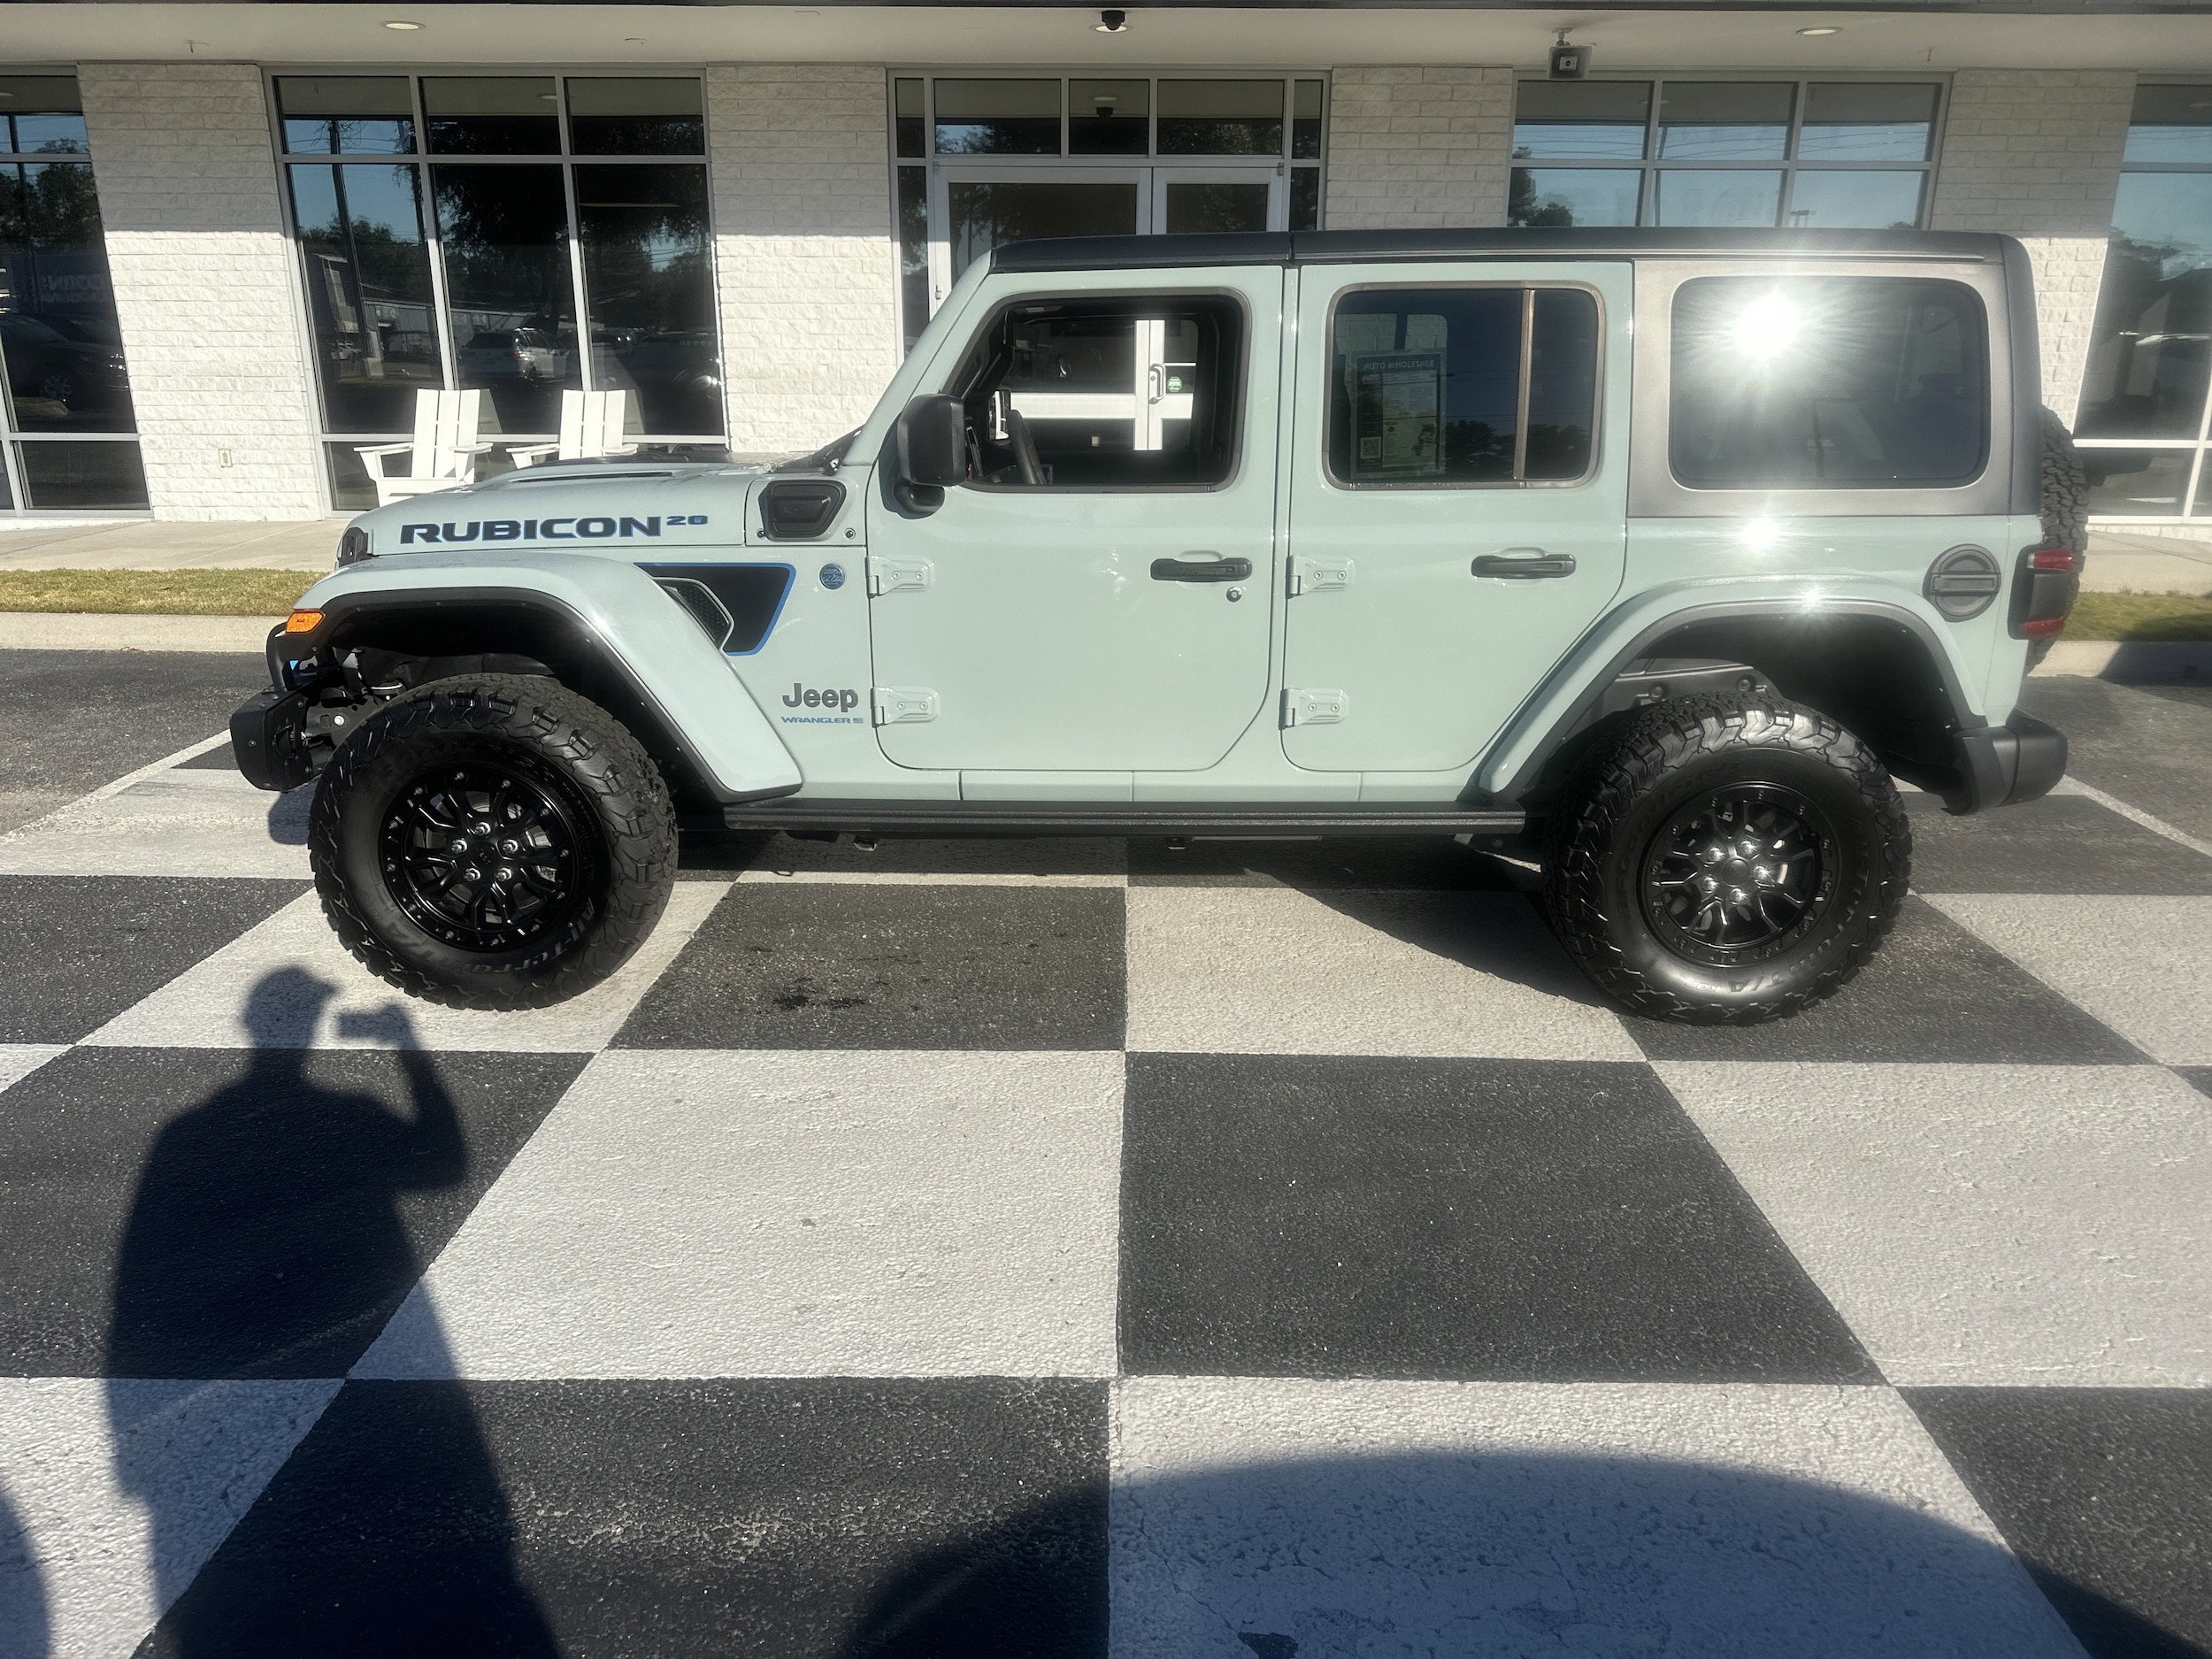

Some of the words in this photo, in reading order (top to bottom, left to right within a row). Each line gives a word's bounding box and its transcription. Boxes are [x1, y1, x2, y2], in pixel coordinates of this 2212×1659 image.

[1363, 361, 1386, 370] AUTO
[1387, 359, 1435, 369] WHOLESALE
[400, 516, 662, 545] RUBICON
[781, 682, 859, 713] Jeep
